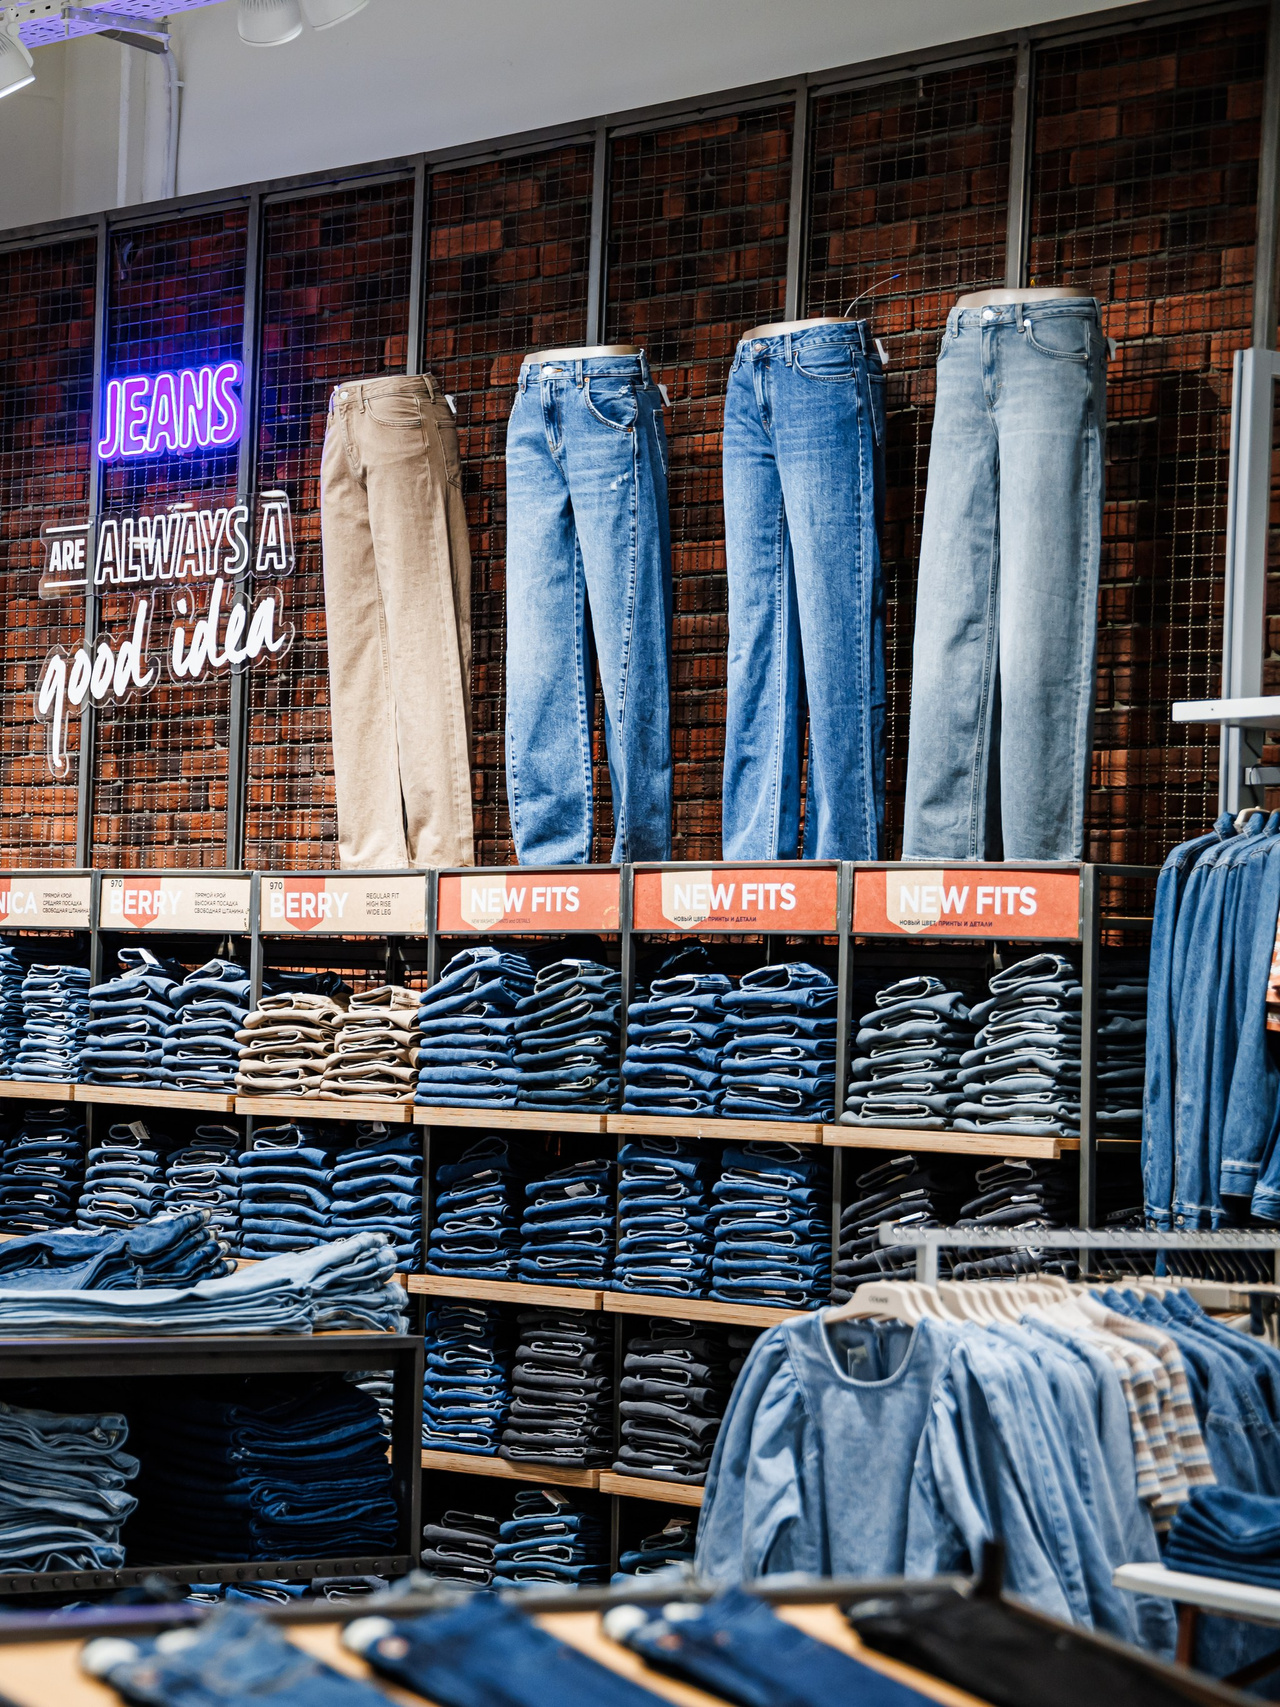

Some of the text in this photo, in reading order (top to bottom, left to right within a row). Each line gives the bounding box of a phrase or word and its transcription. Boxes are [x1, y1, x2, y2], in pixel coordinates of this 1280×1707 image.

[98, 362, 239, 459] JEANS
[48, 503, 287, 585] ARE ALWAYS A
[38, 578, 287, 767] good idea
[110, 880, 123, 888] 970
[269, 881, 283, 890] 970
[673, 883, 796, 911] NEW FITS
[109, 890, 182, 915] BERRY
[270, 892, 349, 918] BERRY
[470, 886, 580, 913] NEW FITS
[899, 885, 1038, 916] NEW FITS
